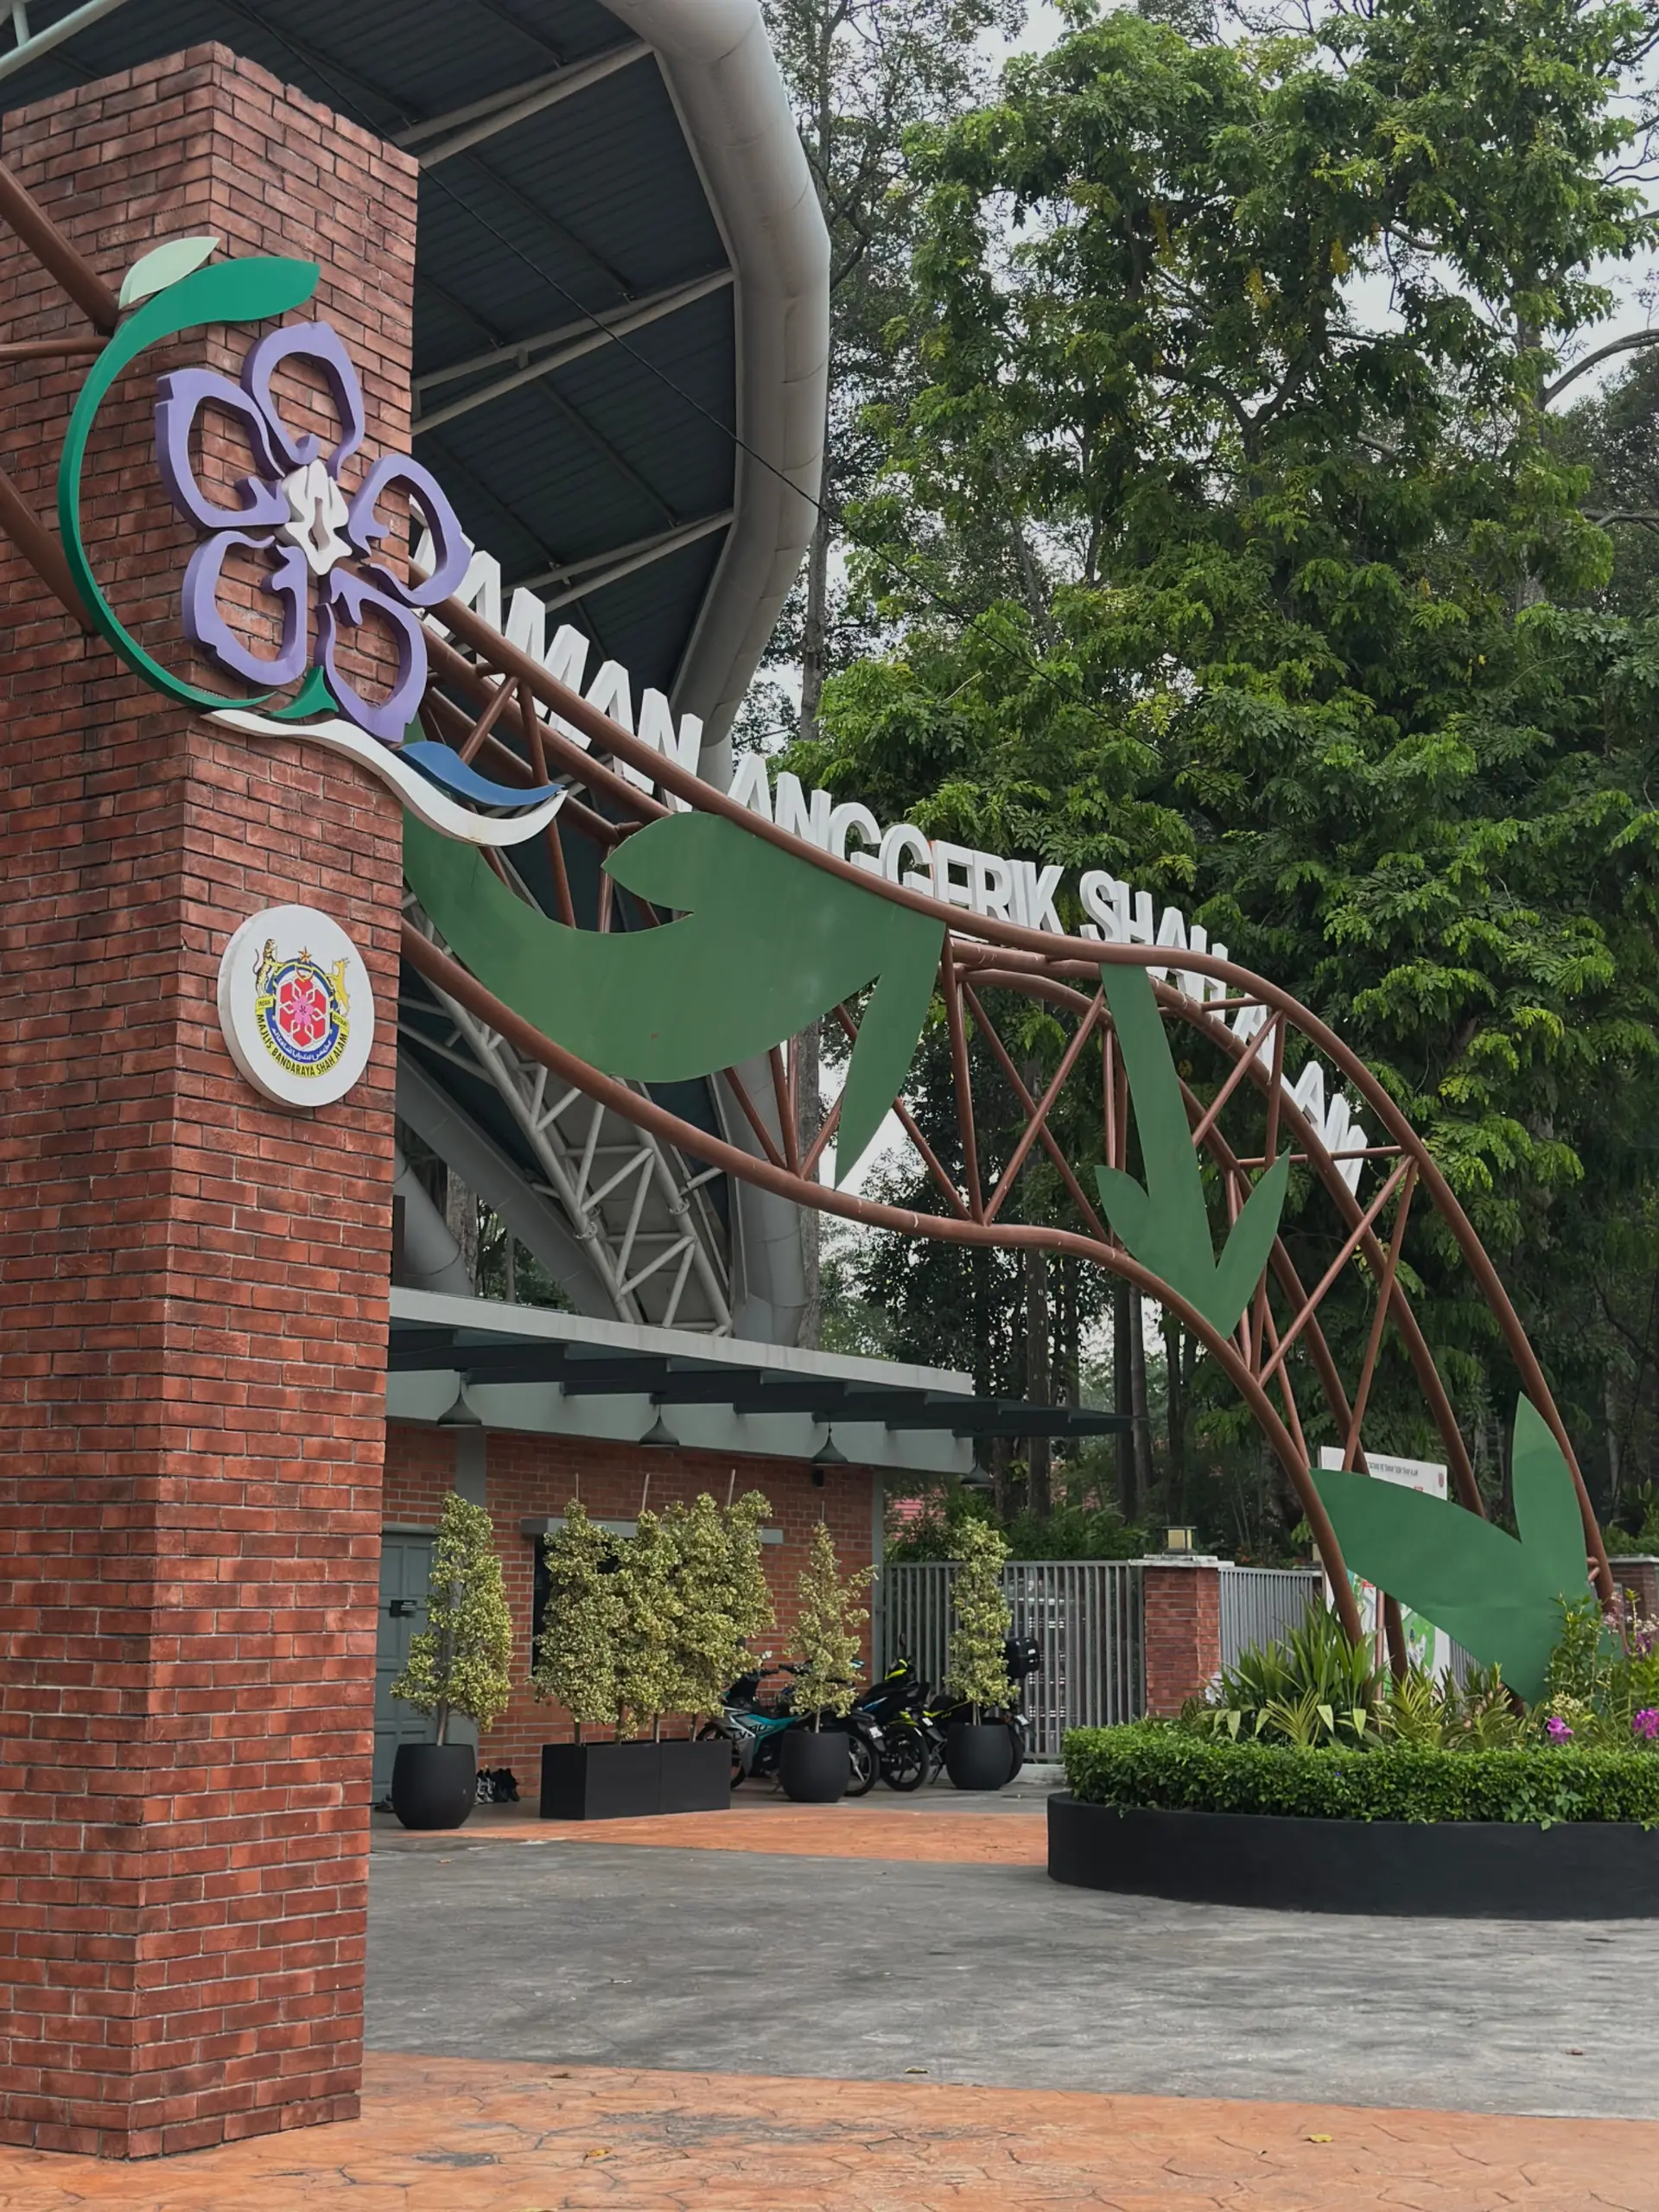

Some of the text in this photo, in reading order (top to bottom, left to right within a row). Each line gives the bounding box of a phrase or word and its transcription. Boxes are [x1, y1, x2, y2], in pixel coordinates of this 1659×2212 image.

[256, 1014, 275, 1049] MAJLIS
[271, 1047, 315, 1077] BANDARAYA
[316, 1055, 335, 1075] SHAH
[334, 1033, 348, 1060] ALAM
[728, 753, 1065, 942] ANGGERIK
[1079, 869, 1229, 1023] SHAH
[1231, 993, 1369, 1198] AAM
